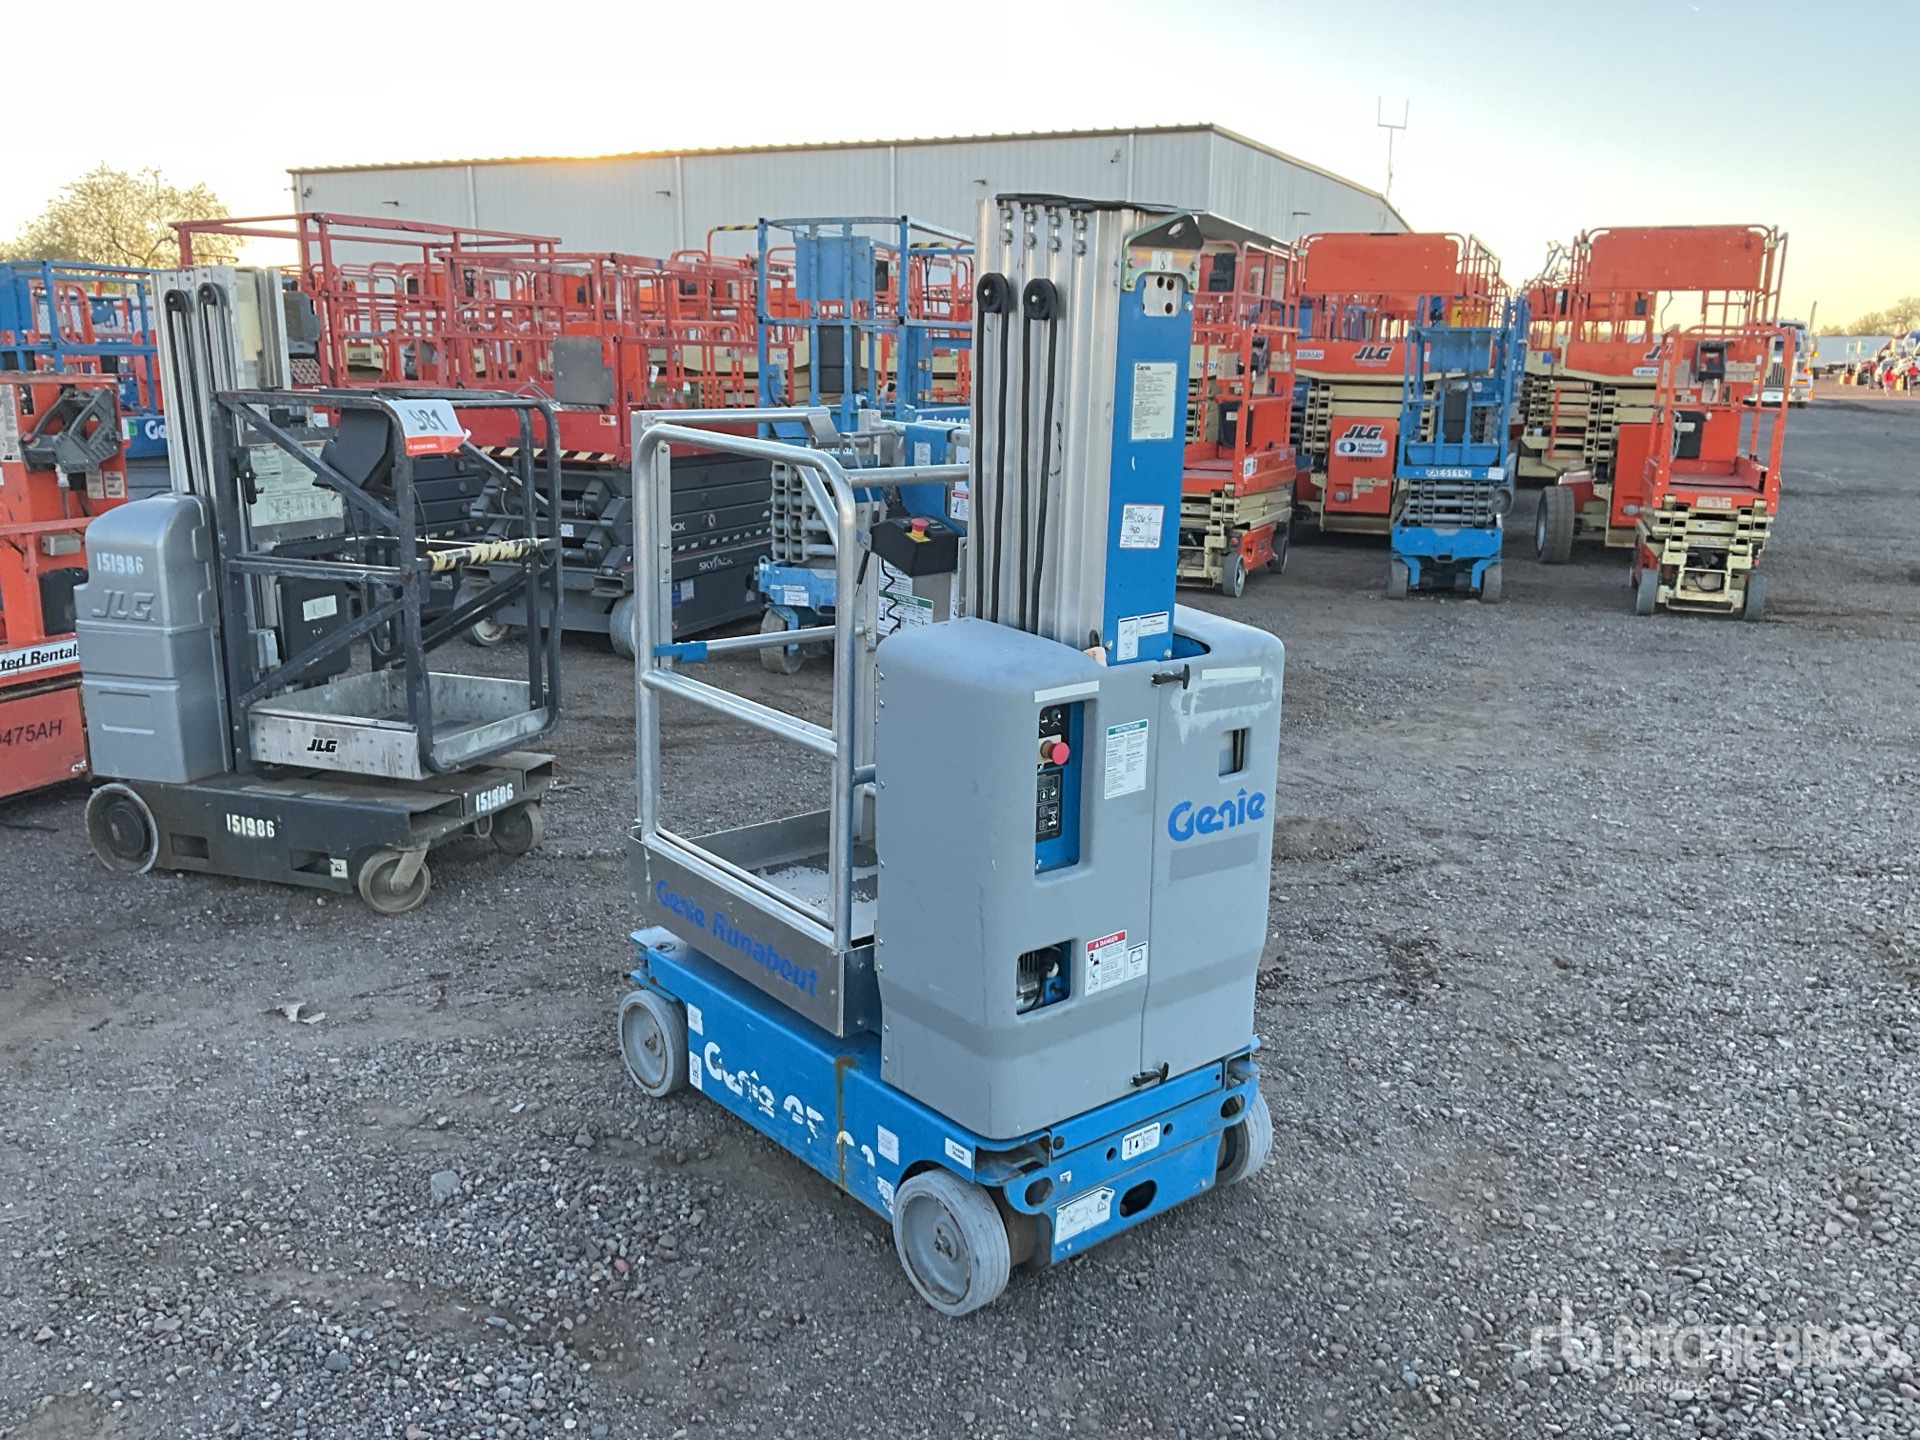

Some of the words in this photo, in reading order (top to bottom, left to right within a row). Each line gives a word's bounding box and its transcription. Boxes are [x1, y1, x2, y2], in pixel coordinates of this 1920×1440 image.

[1354, 347, 1392, 360] JLG
[408, 409, 449, 431] 981
[1344, 426, 1382, 439] JLG
[96, 552, 144, 574] 151986
[92, 589, 154, 622] JLG
[30, 643, 79, 663] Rental
[307, 739, 337, 753] JLG
[475, 782, 514, 812] 151986
[226, 813, 275, 838] 151986
[1167, 787, 1266, 842] Genie
[656, 879, 706, 929] Genie
[711, 911, 818, 997] Runabout
[1100, 935, 1118, 947] DANGER
[704, 1041, 775, 1119] Genie
